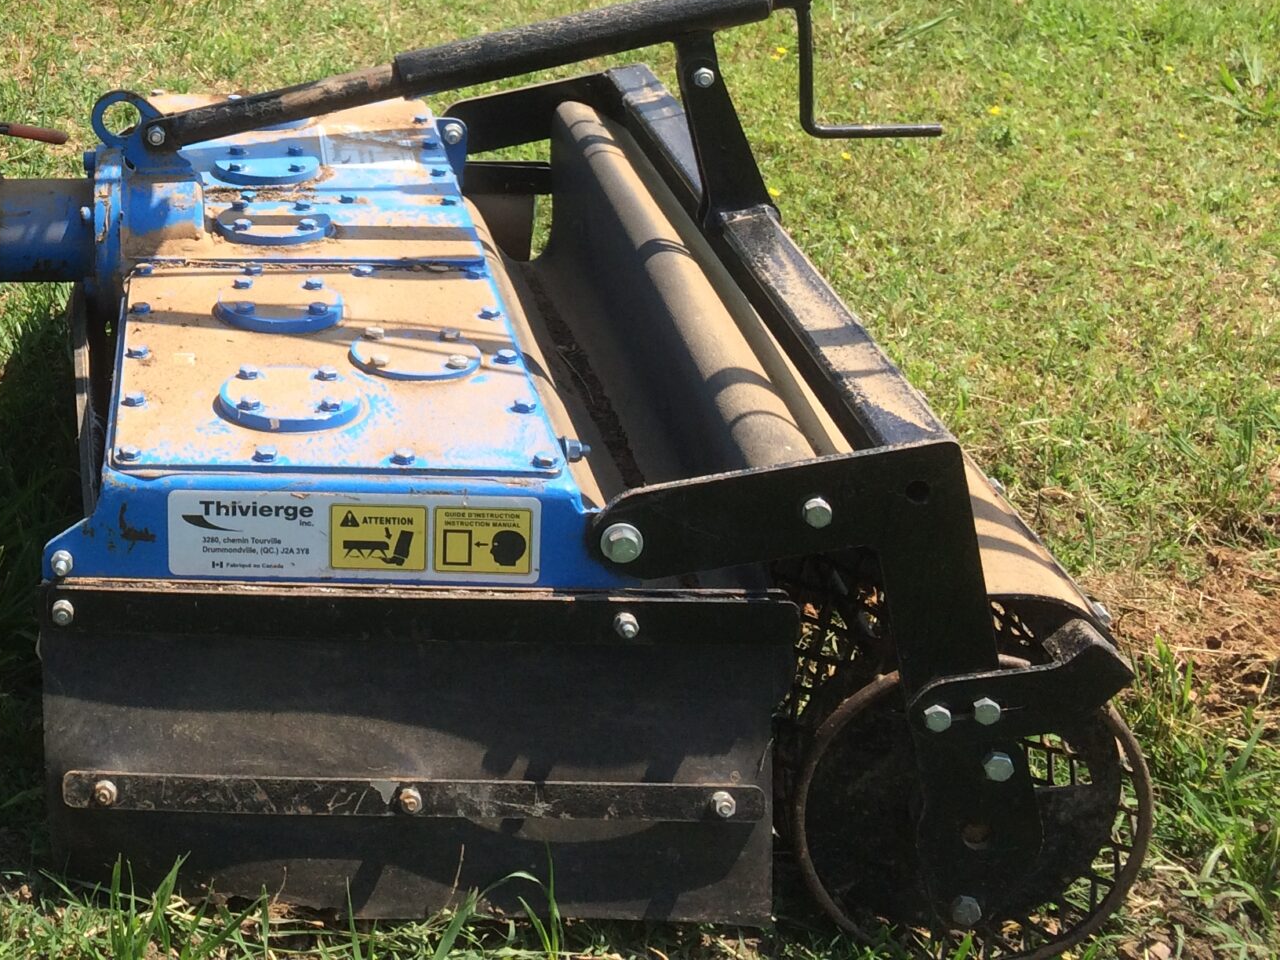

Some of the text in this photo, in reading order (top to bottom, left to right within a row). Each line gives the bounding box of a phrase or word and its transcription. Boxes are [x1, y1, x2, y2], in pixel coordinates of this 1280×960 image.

[199, 500, 314, 520] Thivierge
[362, 516, 414, 526] ATTENTION
[202, 536, 282, 545] 3280, chemin Tourville
[202, 546, 259, 554] Drummondville,
